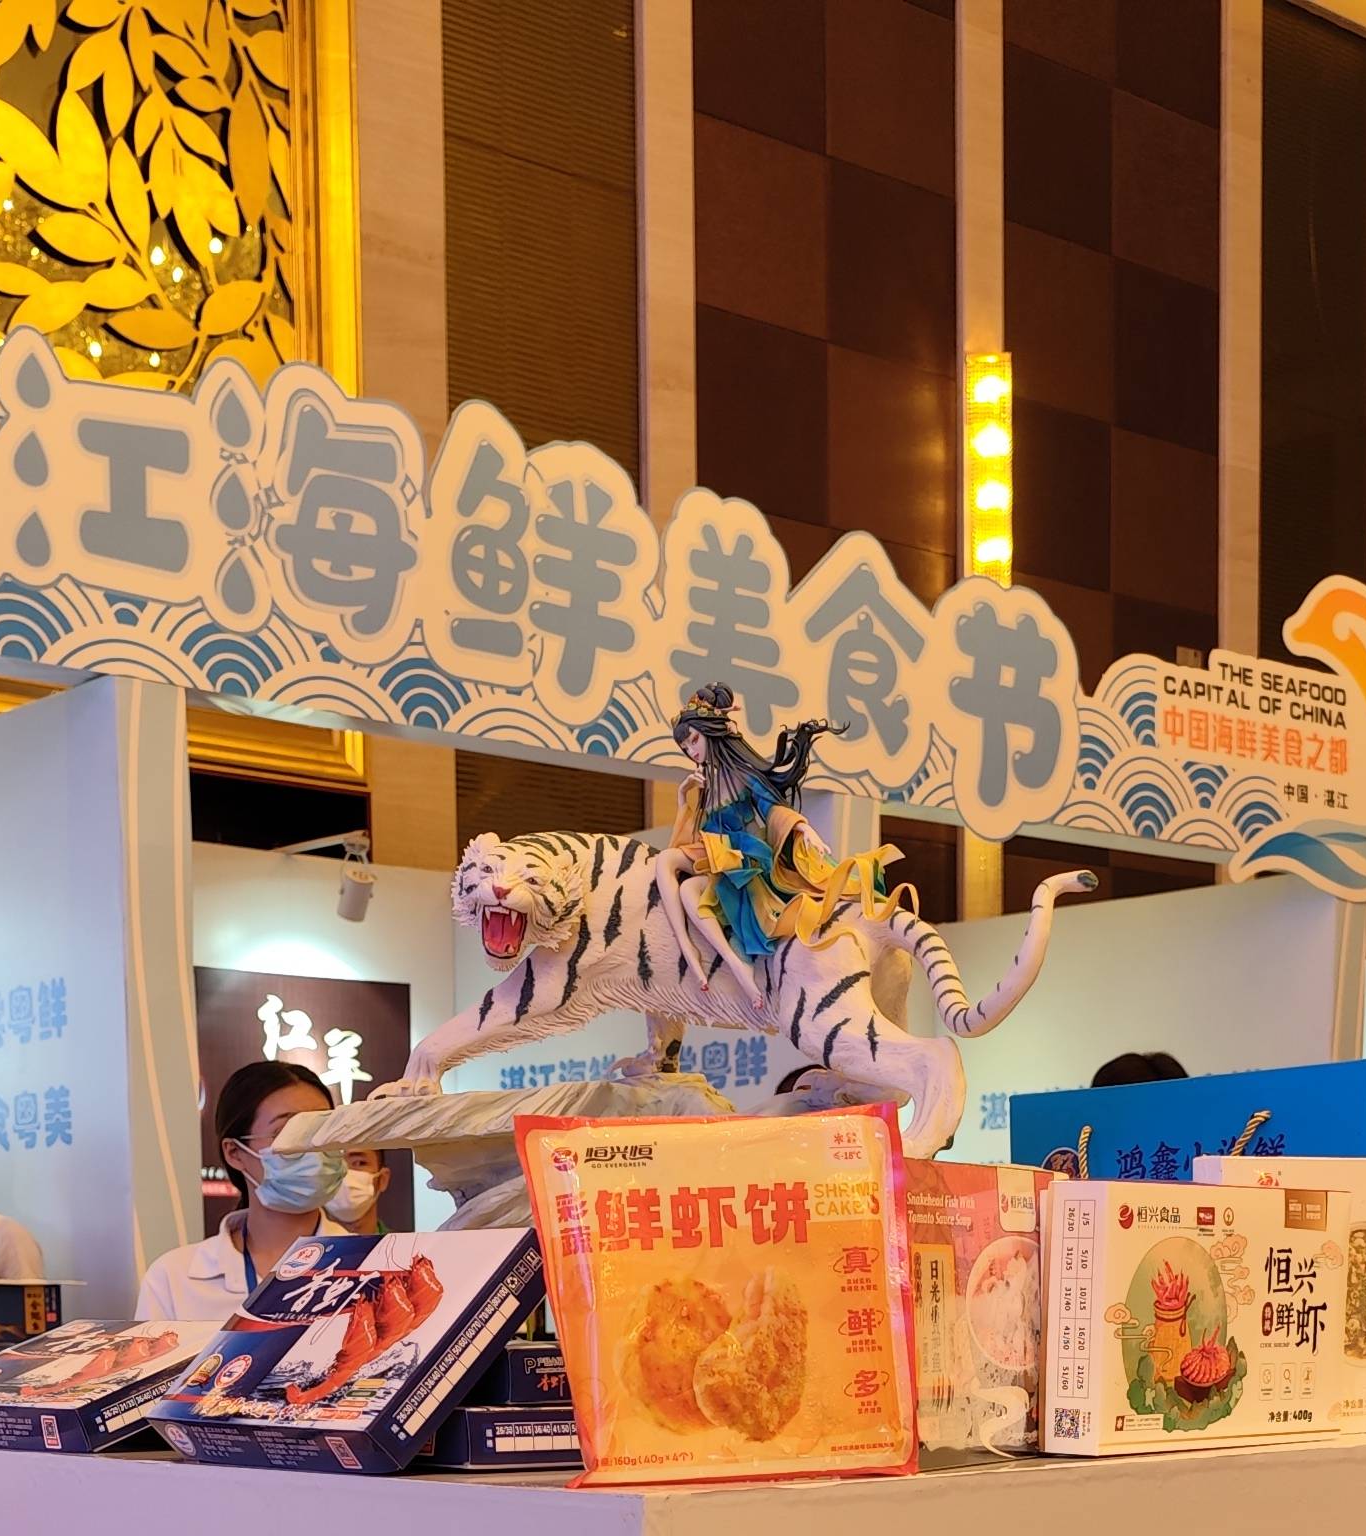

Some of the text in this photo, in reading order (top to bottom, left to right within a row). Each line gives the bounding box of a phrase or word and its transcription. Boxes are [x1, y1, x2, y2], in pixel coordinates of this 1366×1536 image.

[1164, 675, 1347, 729] CAPITAL OF CHINA
[1218, 662, 1347, 706] THE SEAFOOD
[1163, 705, 1348, 775] 中国海鲜美食之都
[595, 1181, 810, 1251] 鲜虾饼
[907, 1192, 944, 1209] Snakehead
[908, 1211, 934, 1225] Tomato
[935, 1212, 954, 1225] Sauce
[1137, 1205, 1181, 1224] 恒兴食品
[842, 1247, 871, 1274] 真
[1264, 1247, 1317, 1297] 恒兴
[848, 1308, 876, 1336] 鲜
[1275, 1298, 1327, 1355] 鲜虾
[854, 1370, 880, 1398] 多
